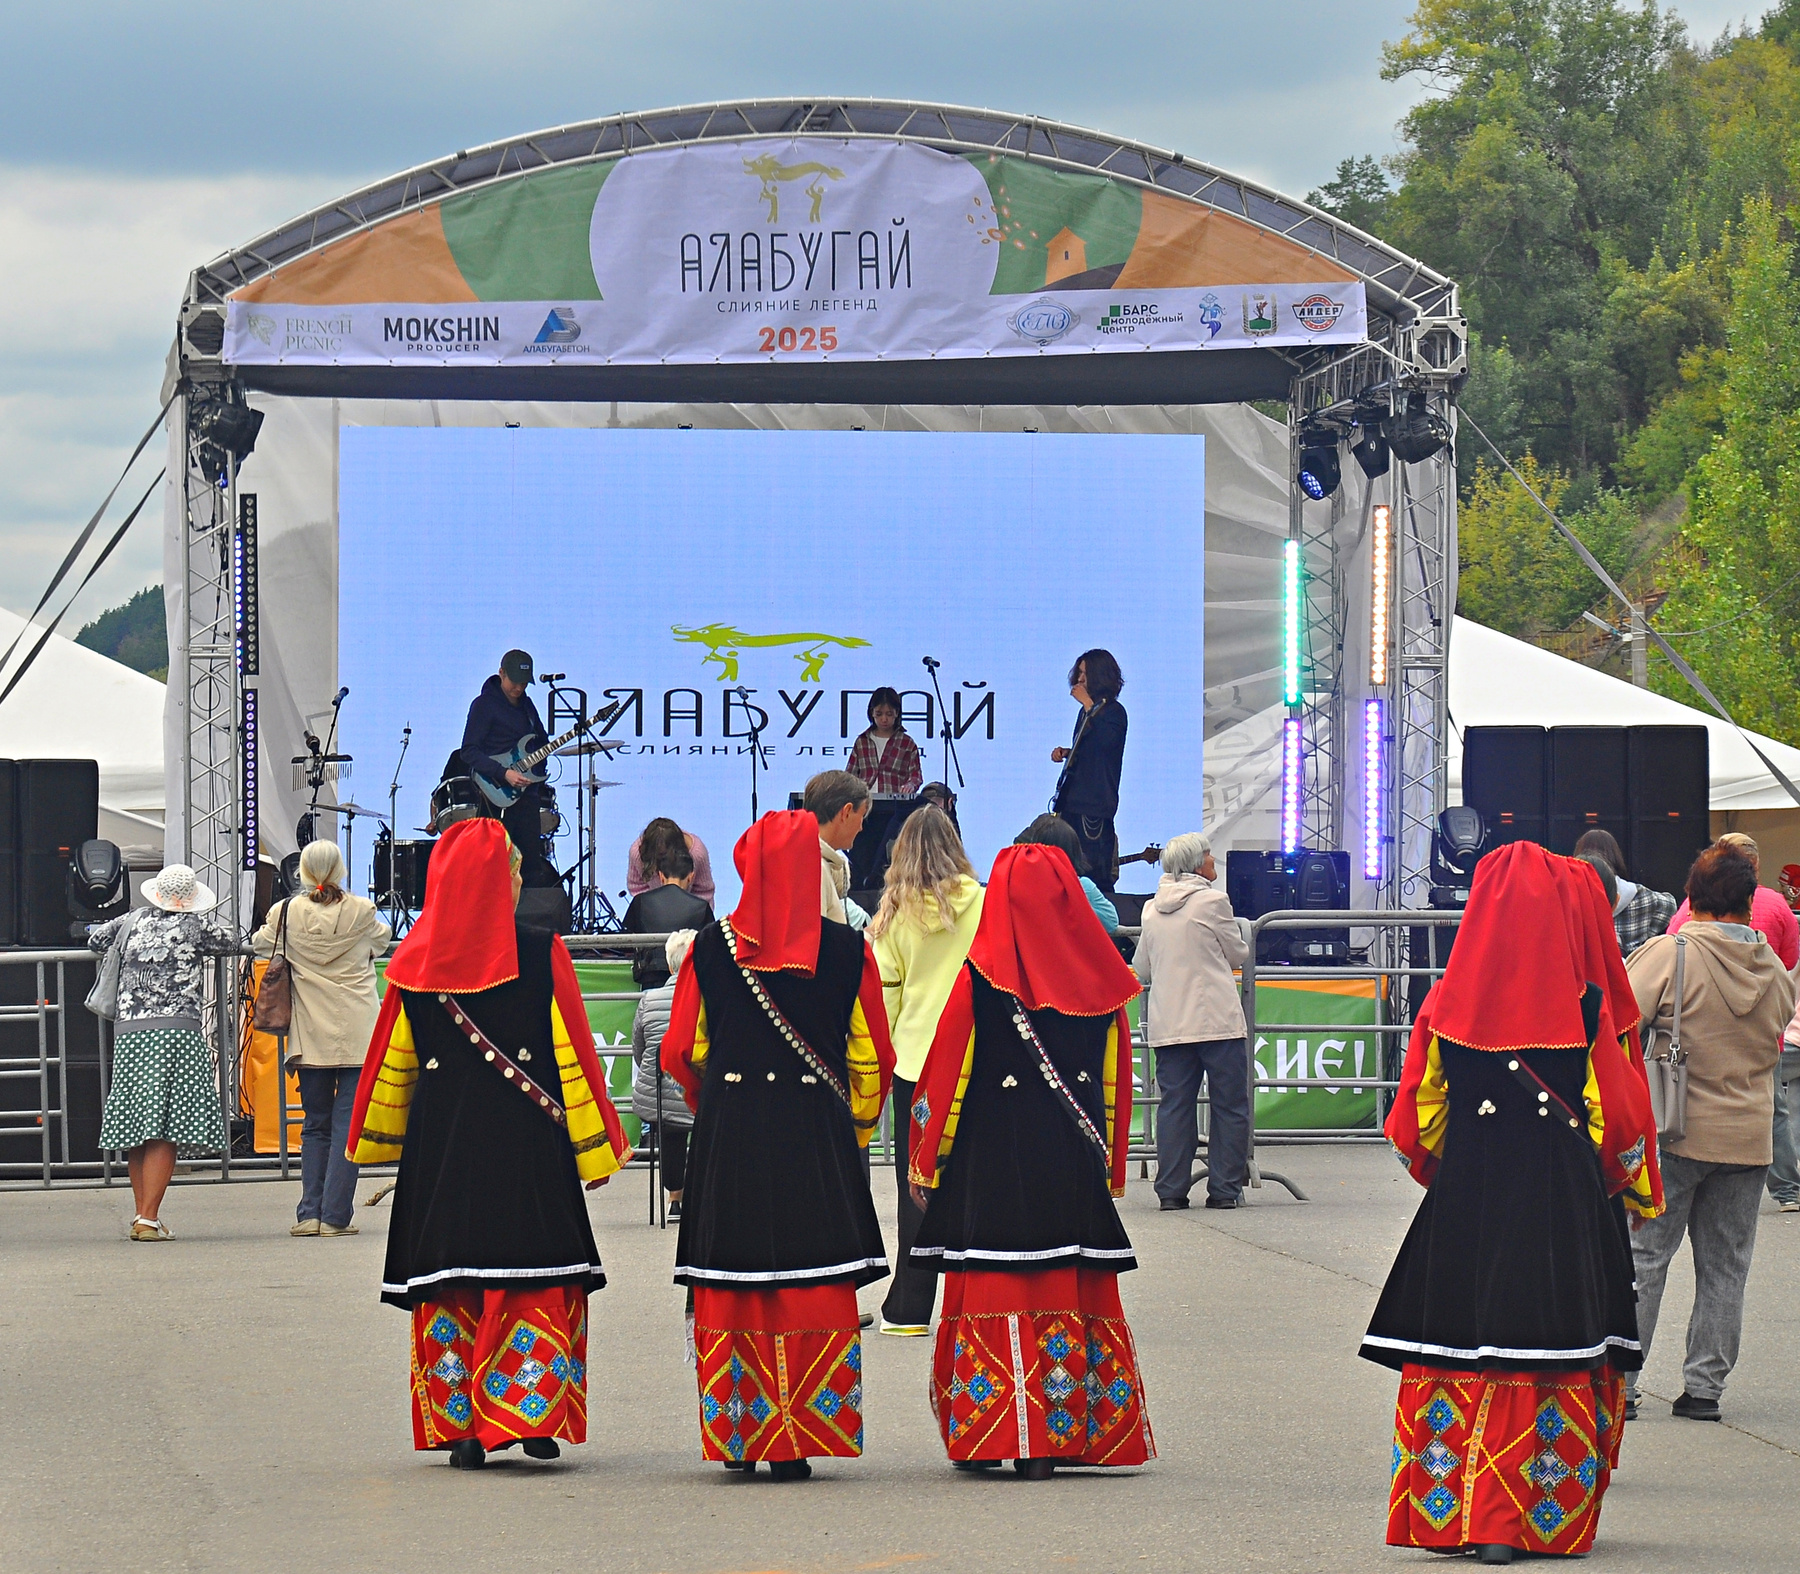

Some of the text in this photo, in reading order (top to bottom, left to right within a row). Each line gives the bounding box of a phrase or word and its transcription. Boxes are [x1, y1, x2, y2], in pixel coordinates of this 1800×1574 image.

[680, 217, 912, 292] АЛАБУГАЙ
[717, 298, 878, 313] СЛИЯНИЕ ЛЕГЕНД
[1122, 304, 1159, 316] БАРС
[1299, 307, 1339, 316] ЛИДЕР
[1111, 313, 1184, 325] молодёжный
[286, 318, 352, 334] FRENCH
[384, 317, 500, 342] MOKSHIN
[1102, 325, 1135, 335] центр
[286, 335, 342, 350] PICNIC
[759, 326, 838, 352] 2025
[407, 344, 480, 352] PRODUCER
[523, 344, 590, 353] АЛАБУГАБЕТОН
[616, 744, 776, 755] СЛИЯНИЕ
